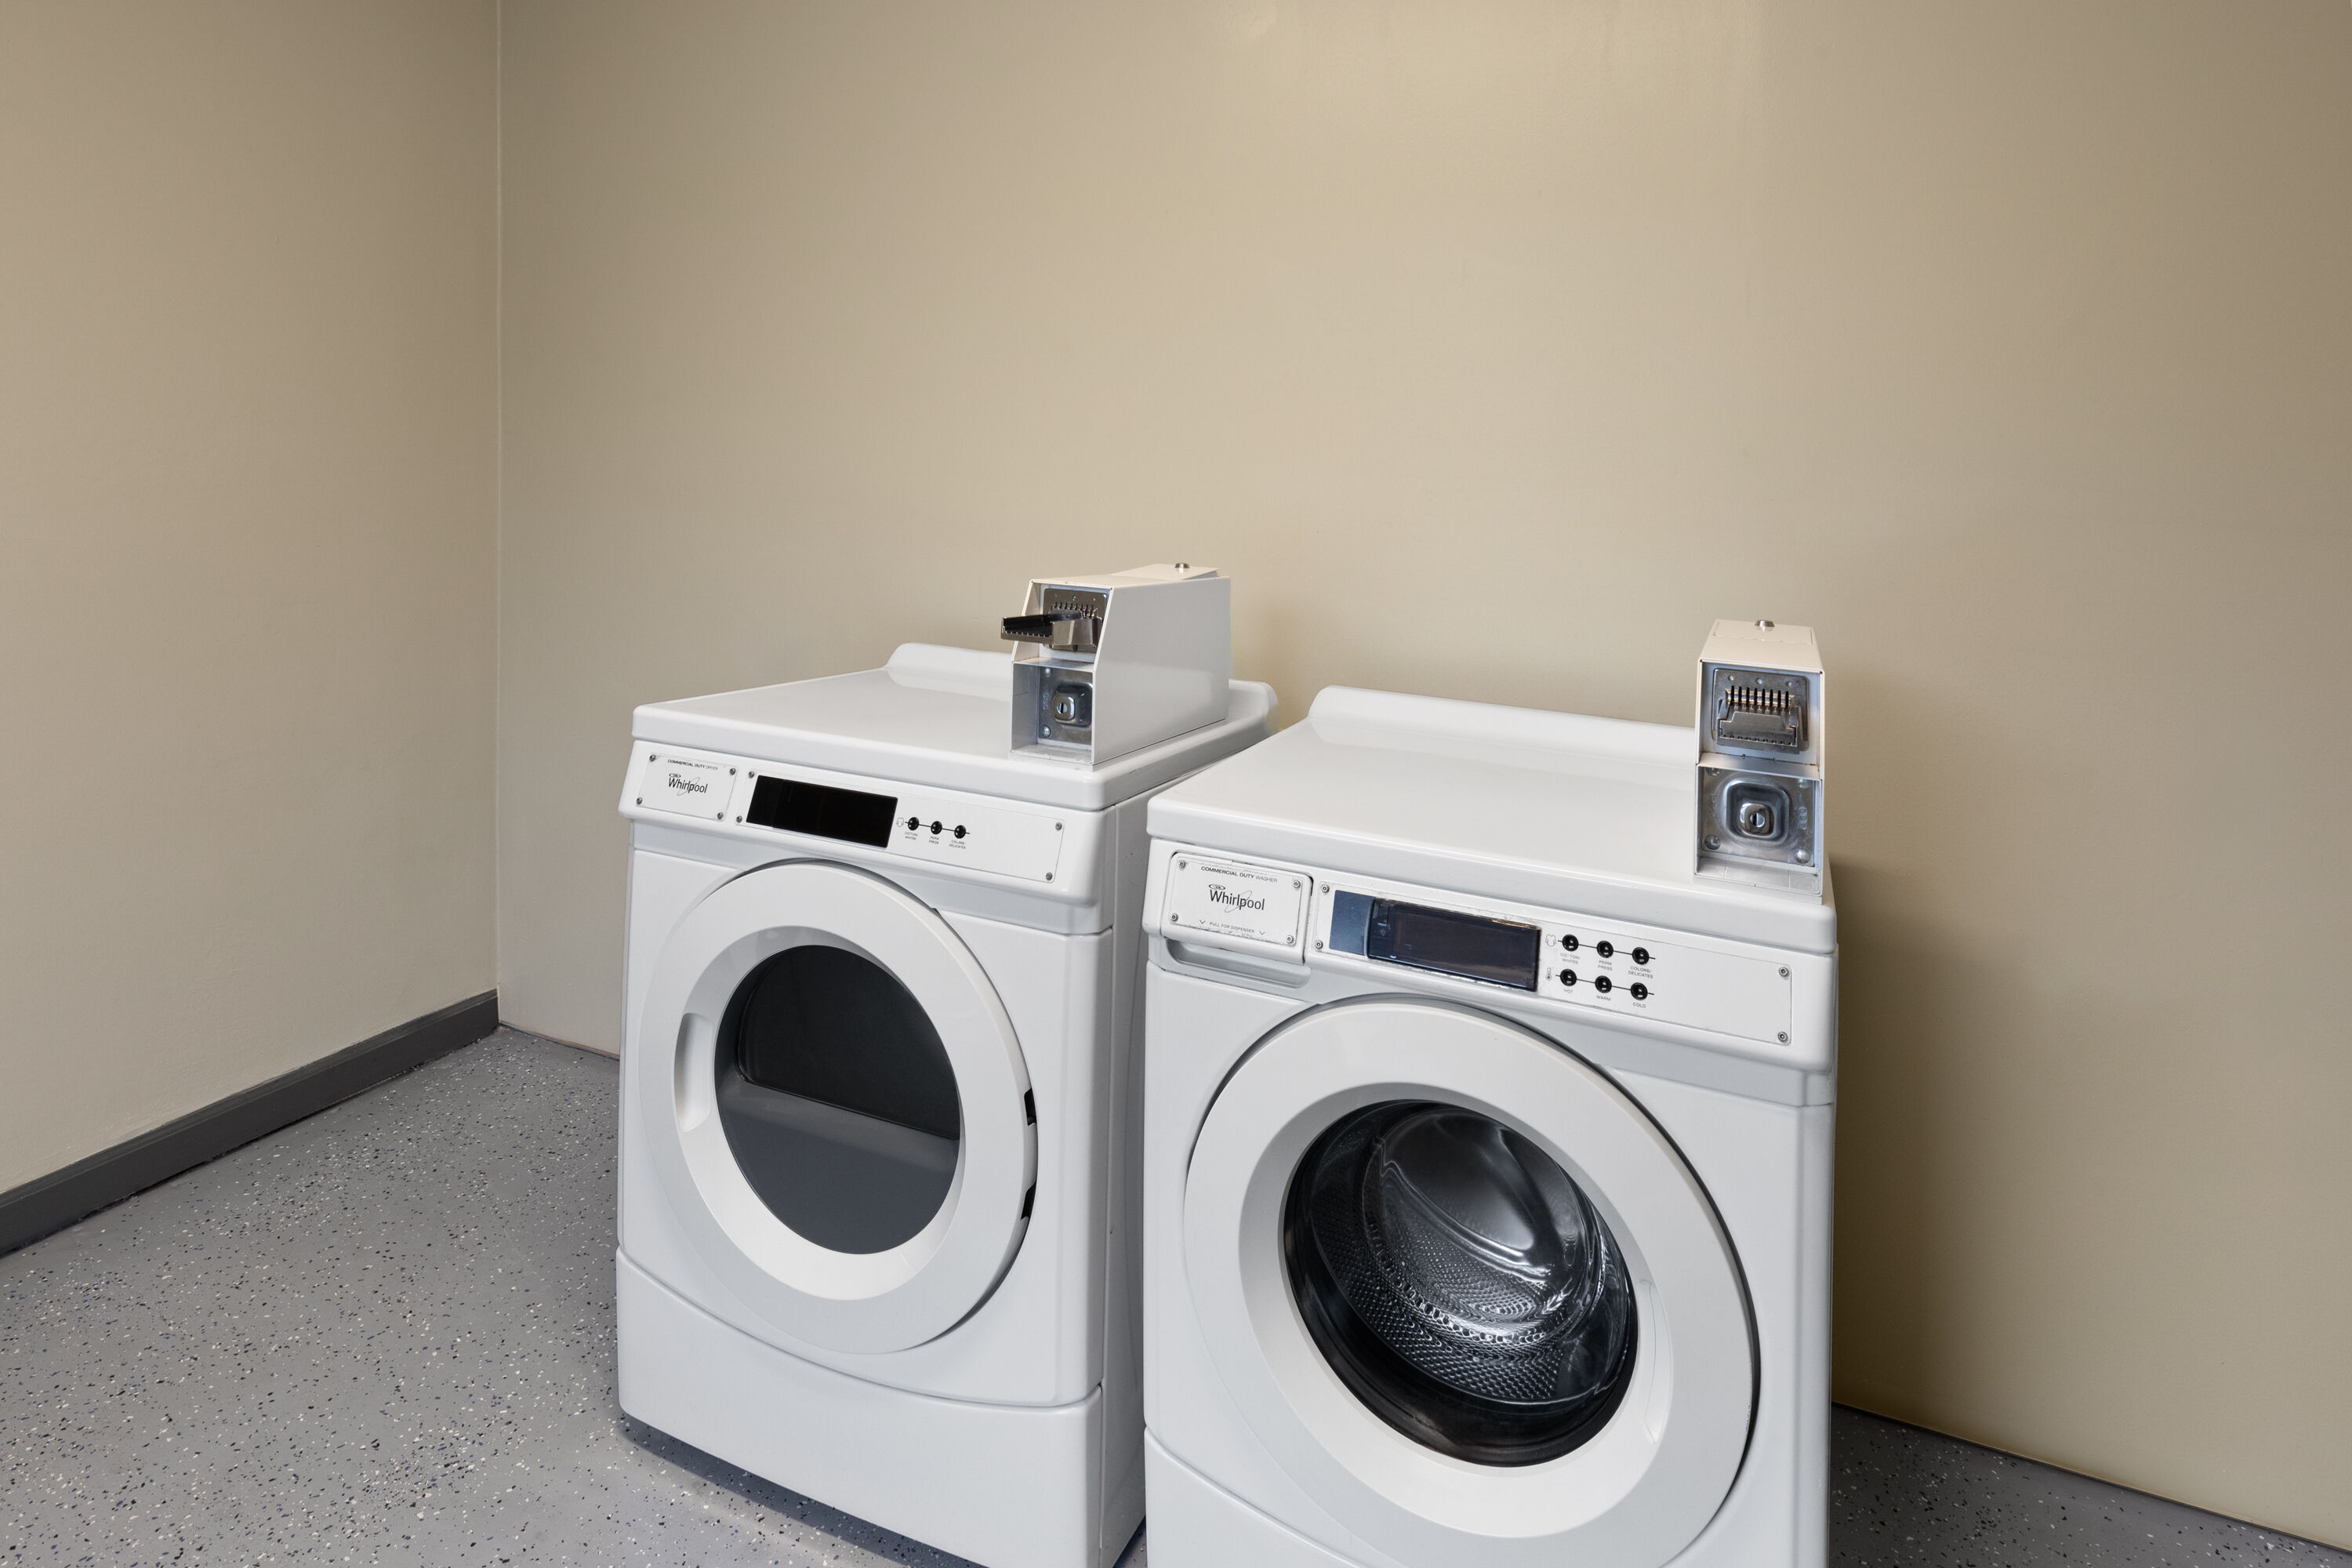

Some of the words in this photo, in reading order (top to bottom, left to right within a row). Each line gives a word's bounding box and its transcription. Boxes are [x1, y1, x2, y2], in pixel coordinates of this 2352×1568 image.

[668, 777, 708, 793] Whirlpool
[1200, 866, 1238, 877] COMMERCIAL
[1210, 889, 1265, 910] Whirlpool
[1230, 925, 1255, 934] DISPENSER
[1628, 971, 1653, 979] DELICATES
